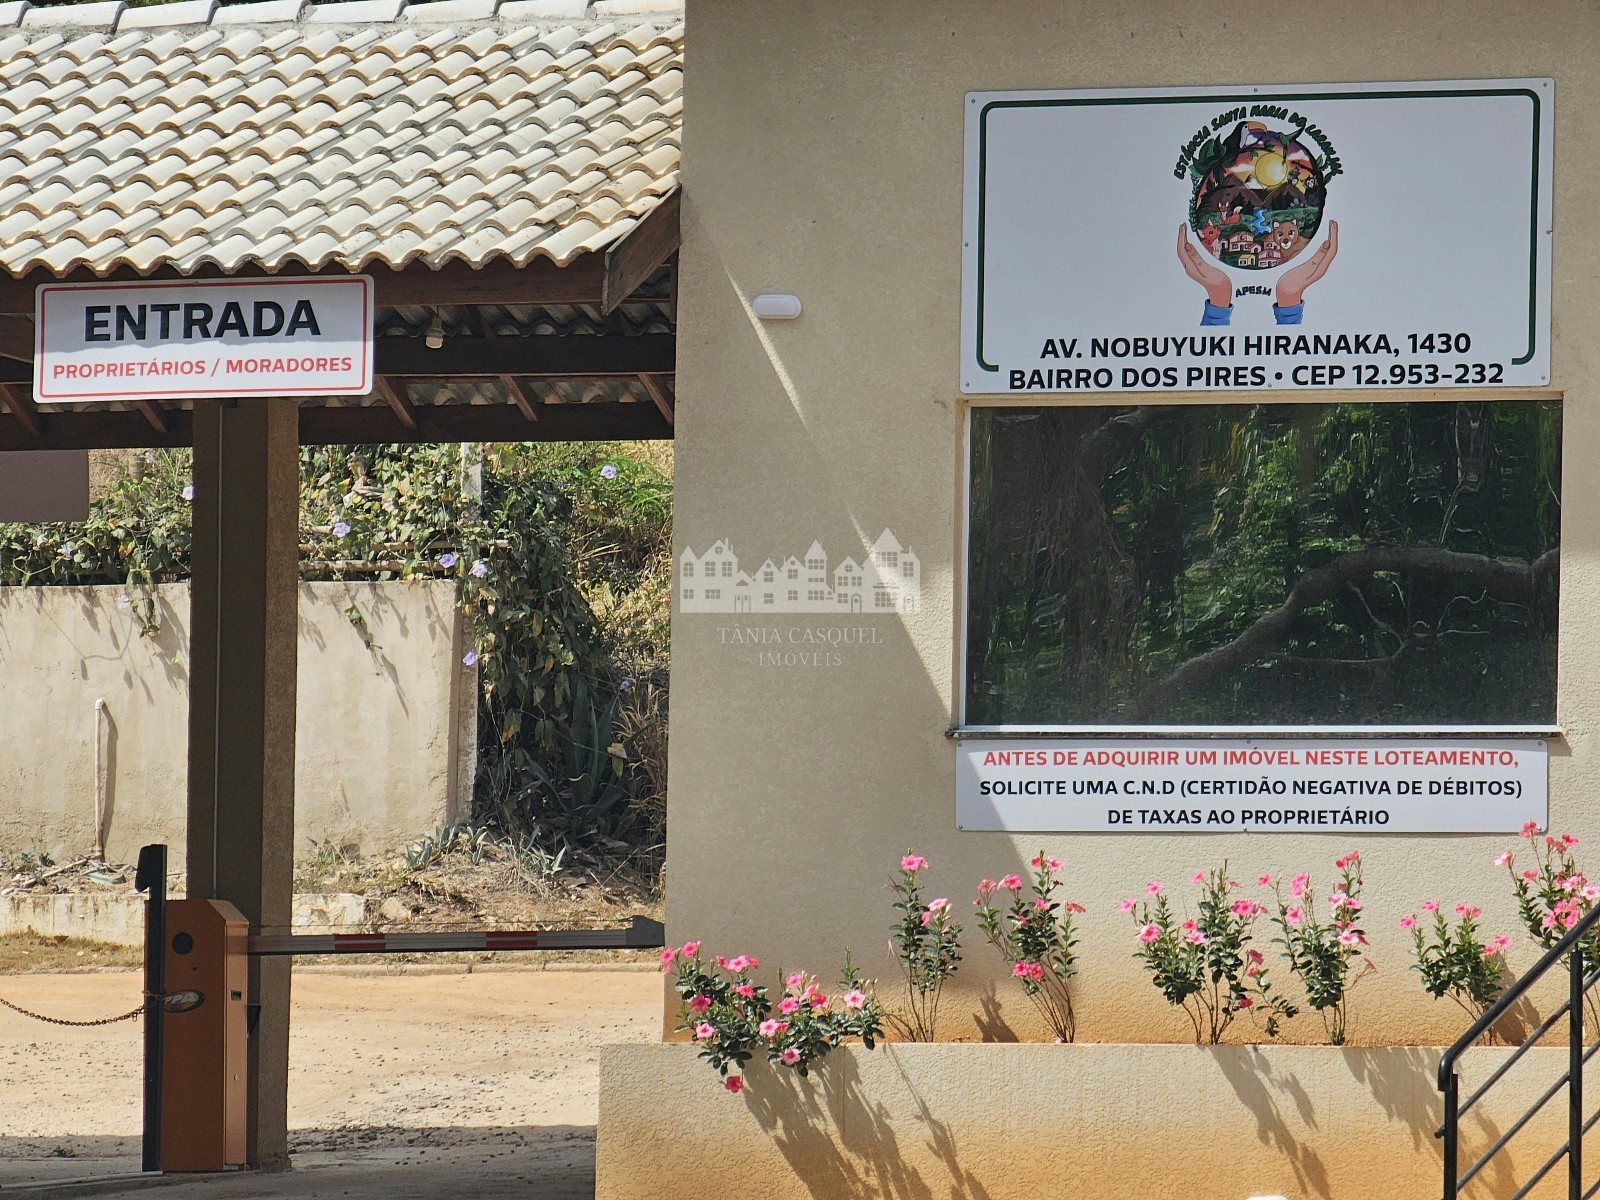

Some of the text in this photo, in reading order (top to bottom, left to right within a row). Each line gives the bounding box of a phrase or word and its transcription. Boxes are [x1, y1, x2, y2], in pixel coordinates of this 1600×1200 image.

[1211, 106, 1246, 132] SANTA
[1250, 105, 1289, 120] MARIA
[1235, 285, 1272, 298] APESM
[85, 299, 321, 342] ENTRADA
[1040, 333, 1472, 360] AV. NOBUYUKI HIRANAKA, 1430
[53, 356, 352, 379] PROPRIETÁRIOS / MORADORES
[1009, 368, 1114, 390] BAIRRO
[1121, 367, 1178, 388] DOS
[1186, 366, 1266, 387] PIRES
[1291, 365, 1346, 386] CEP
[1352, 363, 1504, 385] 12.953-232
[983, 747, 1519, 768] ANTES DE ADQUIRIR UM IMÓVEL NESTE LOTEAMENTO,
[980, 776, 1522, 798] SOLICITE UMA C.N.D (CERTIDÃO NEGATIVA DE DÉBITOS)
[1108, 806, 1389, 825] DE TAXAS AO PROPRIETÁRIO
